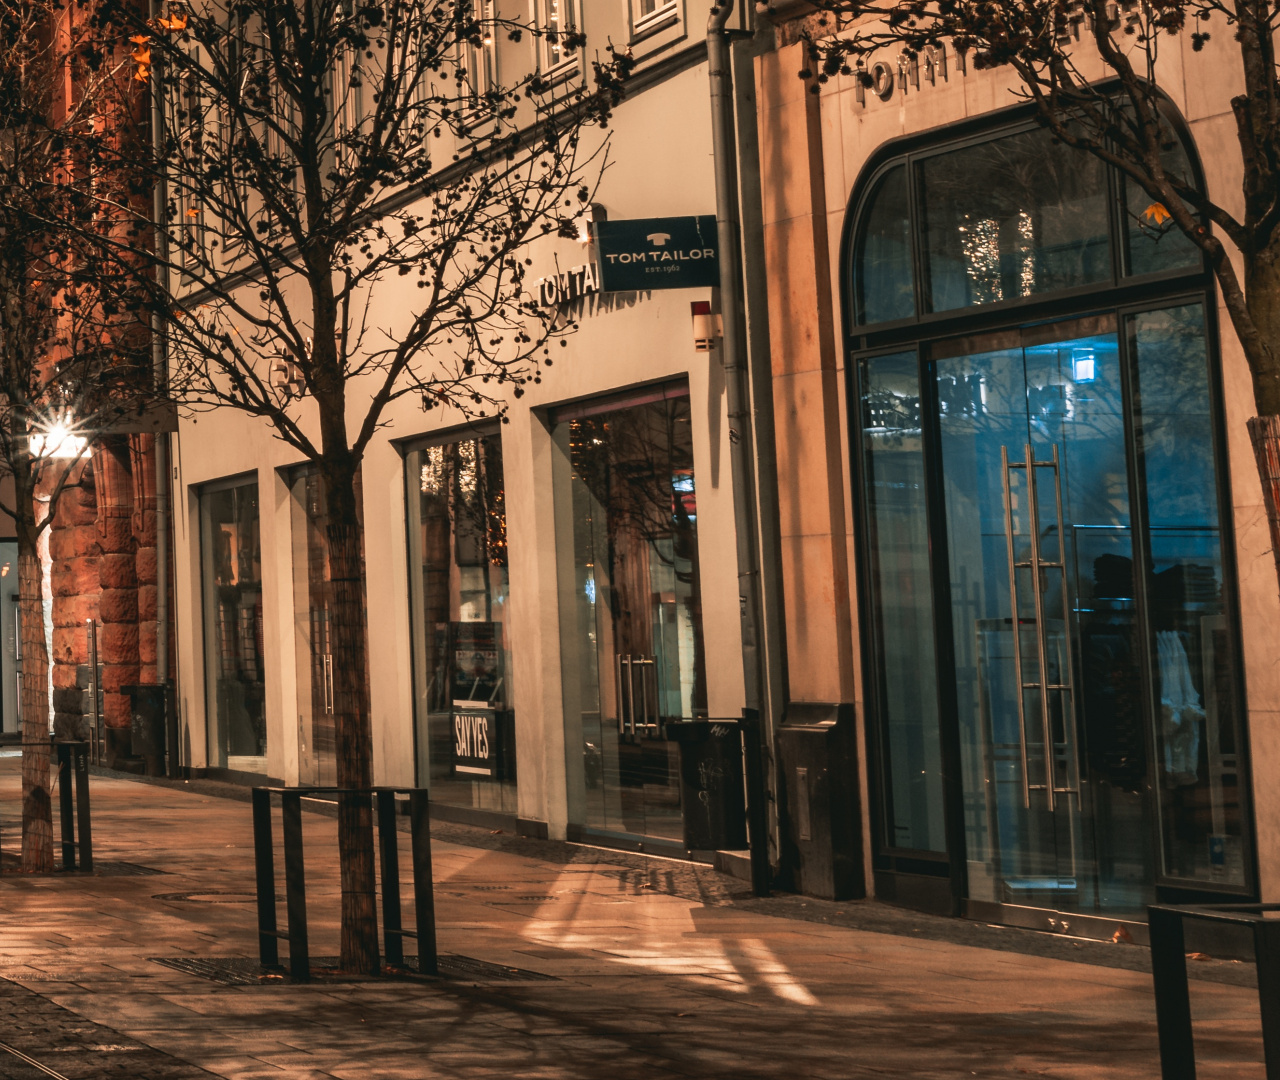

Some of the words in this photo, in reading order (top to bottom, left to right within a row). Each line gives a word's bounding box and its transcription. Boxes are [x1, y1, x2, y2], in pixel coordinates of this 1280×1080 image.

[606, 252, 646, 264] TOM
[648, 248, 715, 262] TAILOR
[533, 271, 571, 307] TOM
[571, 260, 599, 296] TAI
[455, 715, 471, 757] SAY
[471, 716, 489, 759] YES
